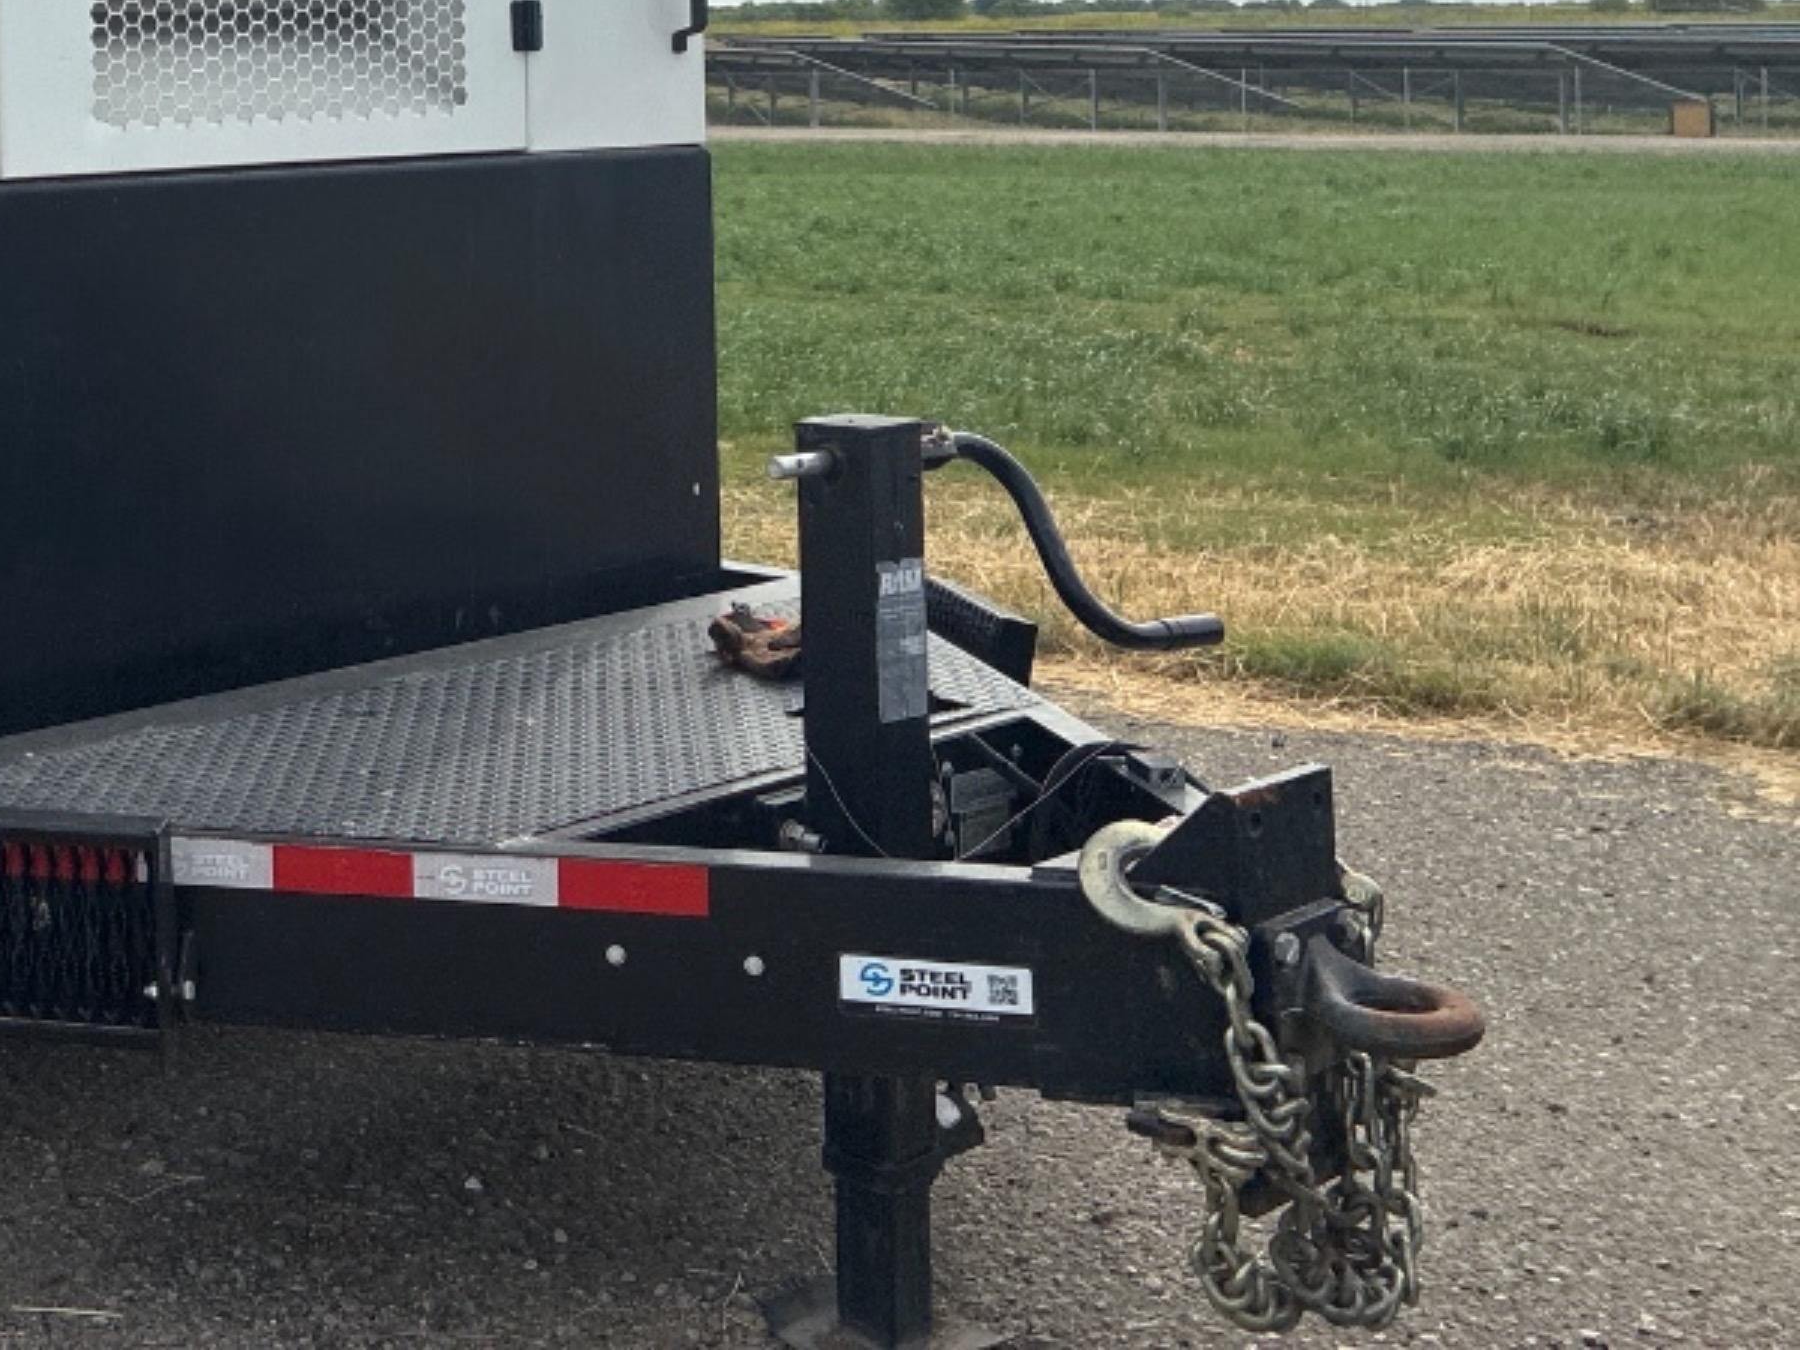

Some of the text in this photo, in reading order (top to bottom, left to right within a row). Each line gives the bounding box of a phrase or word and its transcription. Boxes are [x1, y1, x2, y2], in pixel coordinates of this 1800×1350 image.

[471, 868, 532, 884] STEEL
[471, 880, 533, 896] POINT
[900, 968, 968, 985] STEEL
[900, 983, 970, 1000] POINT
